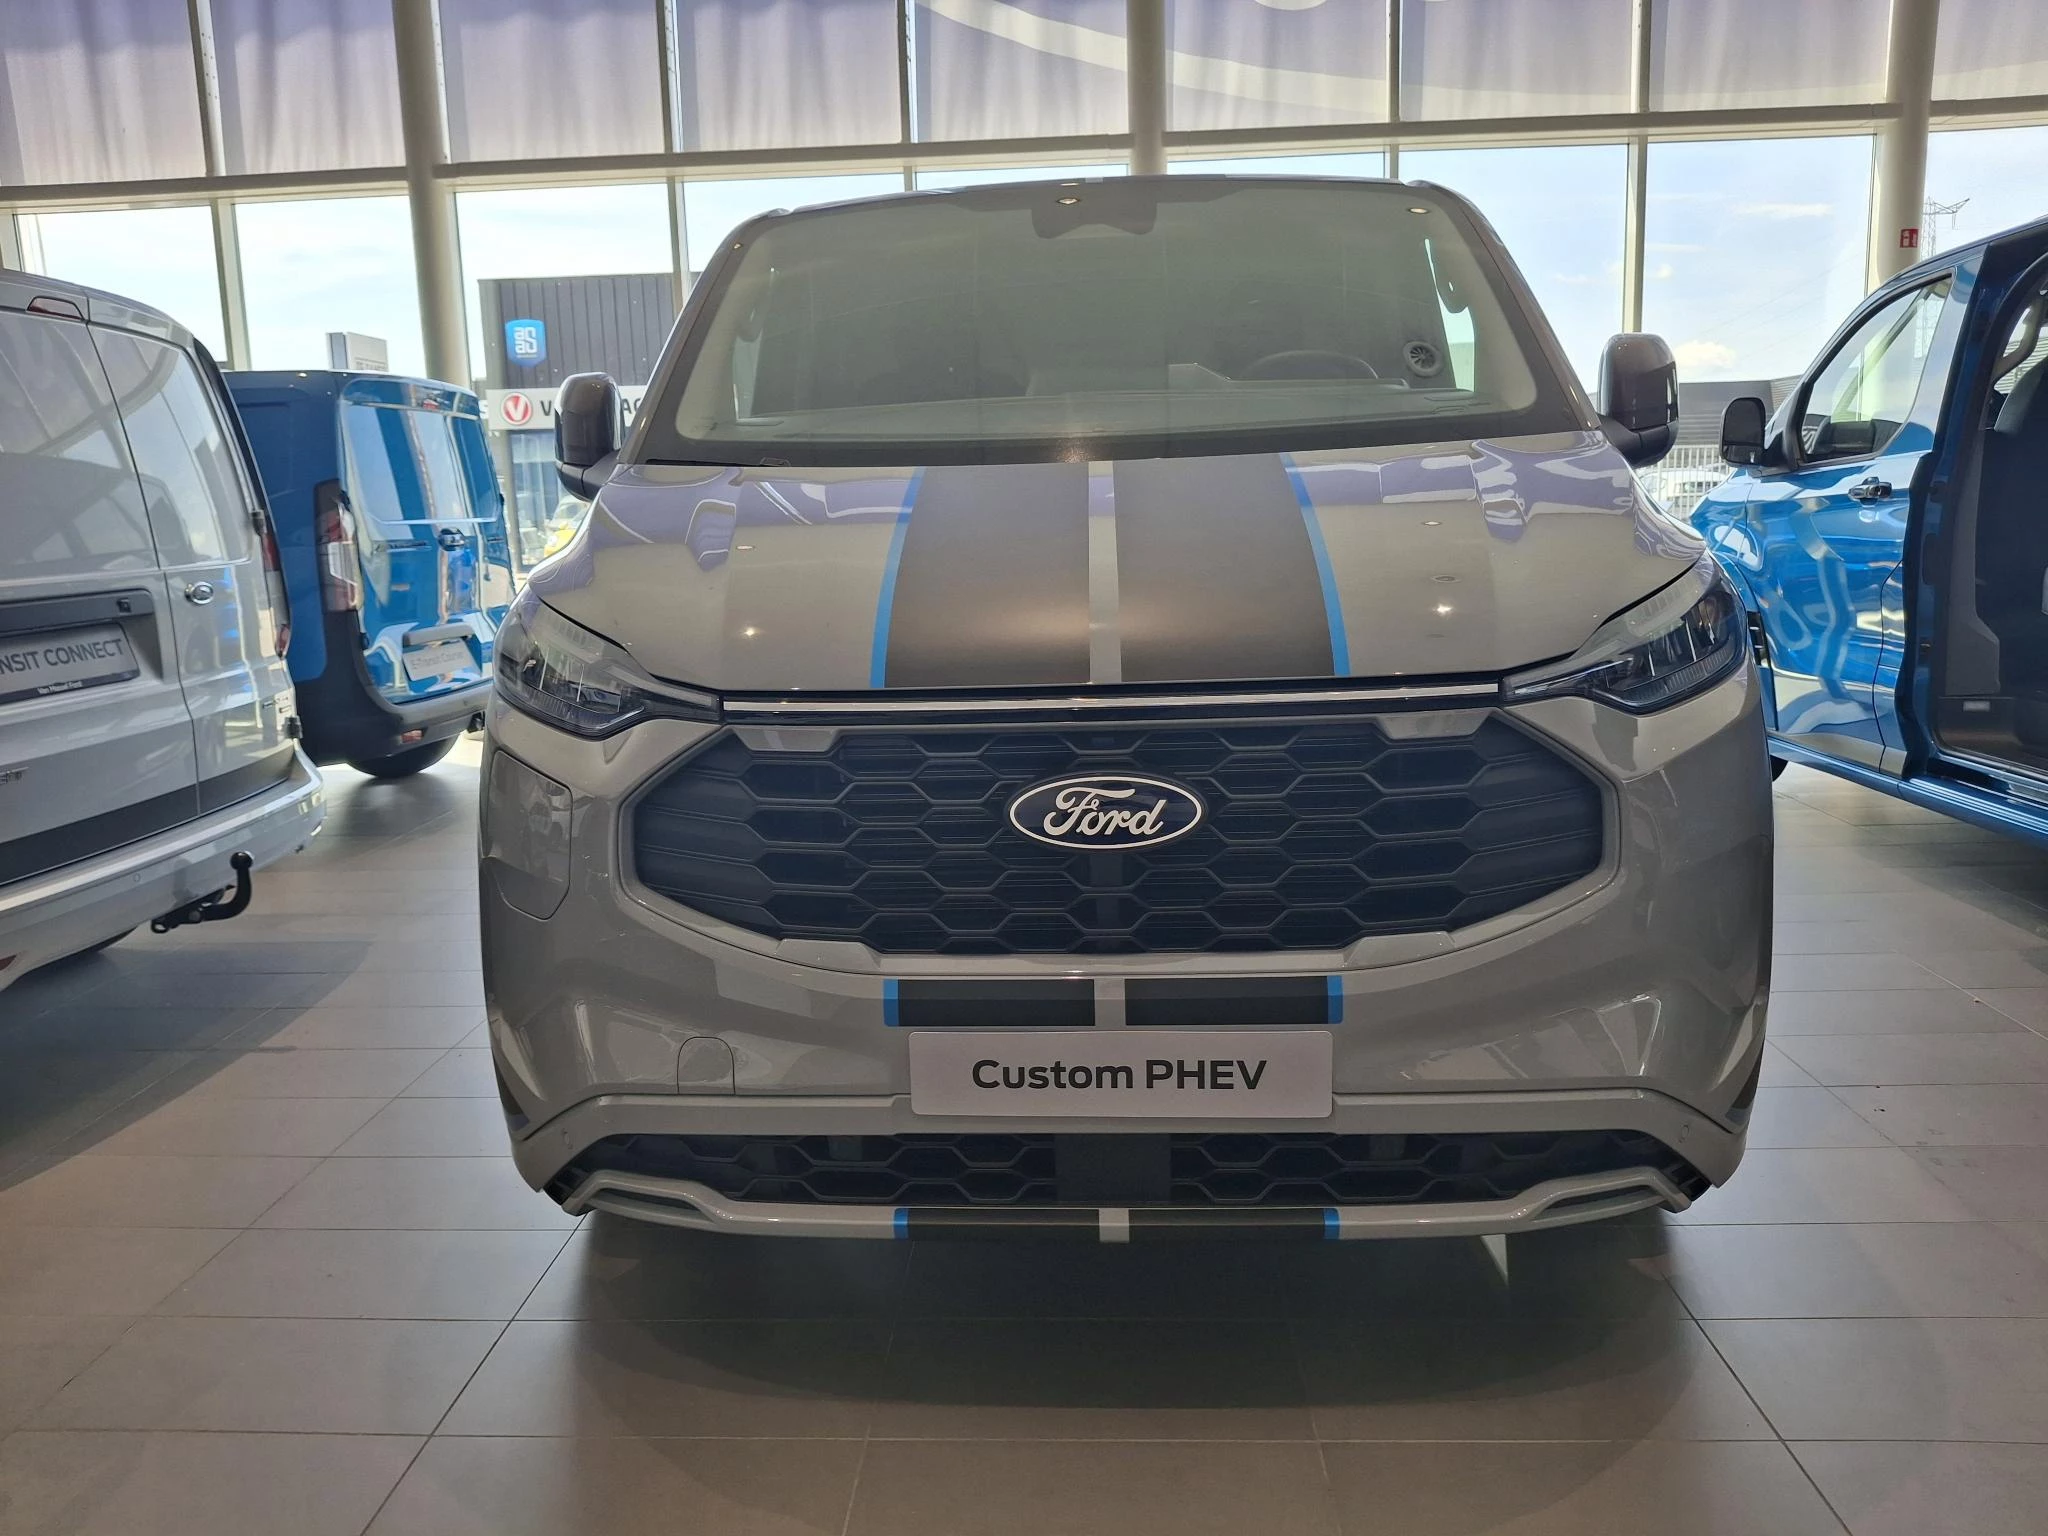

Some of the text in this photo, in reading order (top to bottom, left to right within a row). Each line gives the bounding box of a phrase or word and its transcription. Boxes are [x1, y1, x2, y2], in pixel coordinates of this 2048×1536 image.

[0, 638, 123, 675] NSIT CONNECT
[1043, 786, 1167, 836] Ford
[972, 1059, 1267, 1090] Custom PHEV
